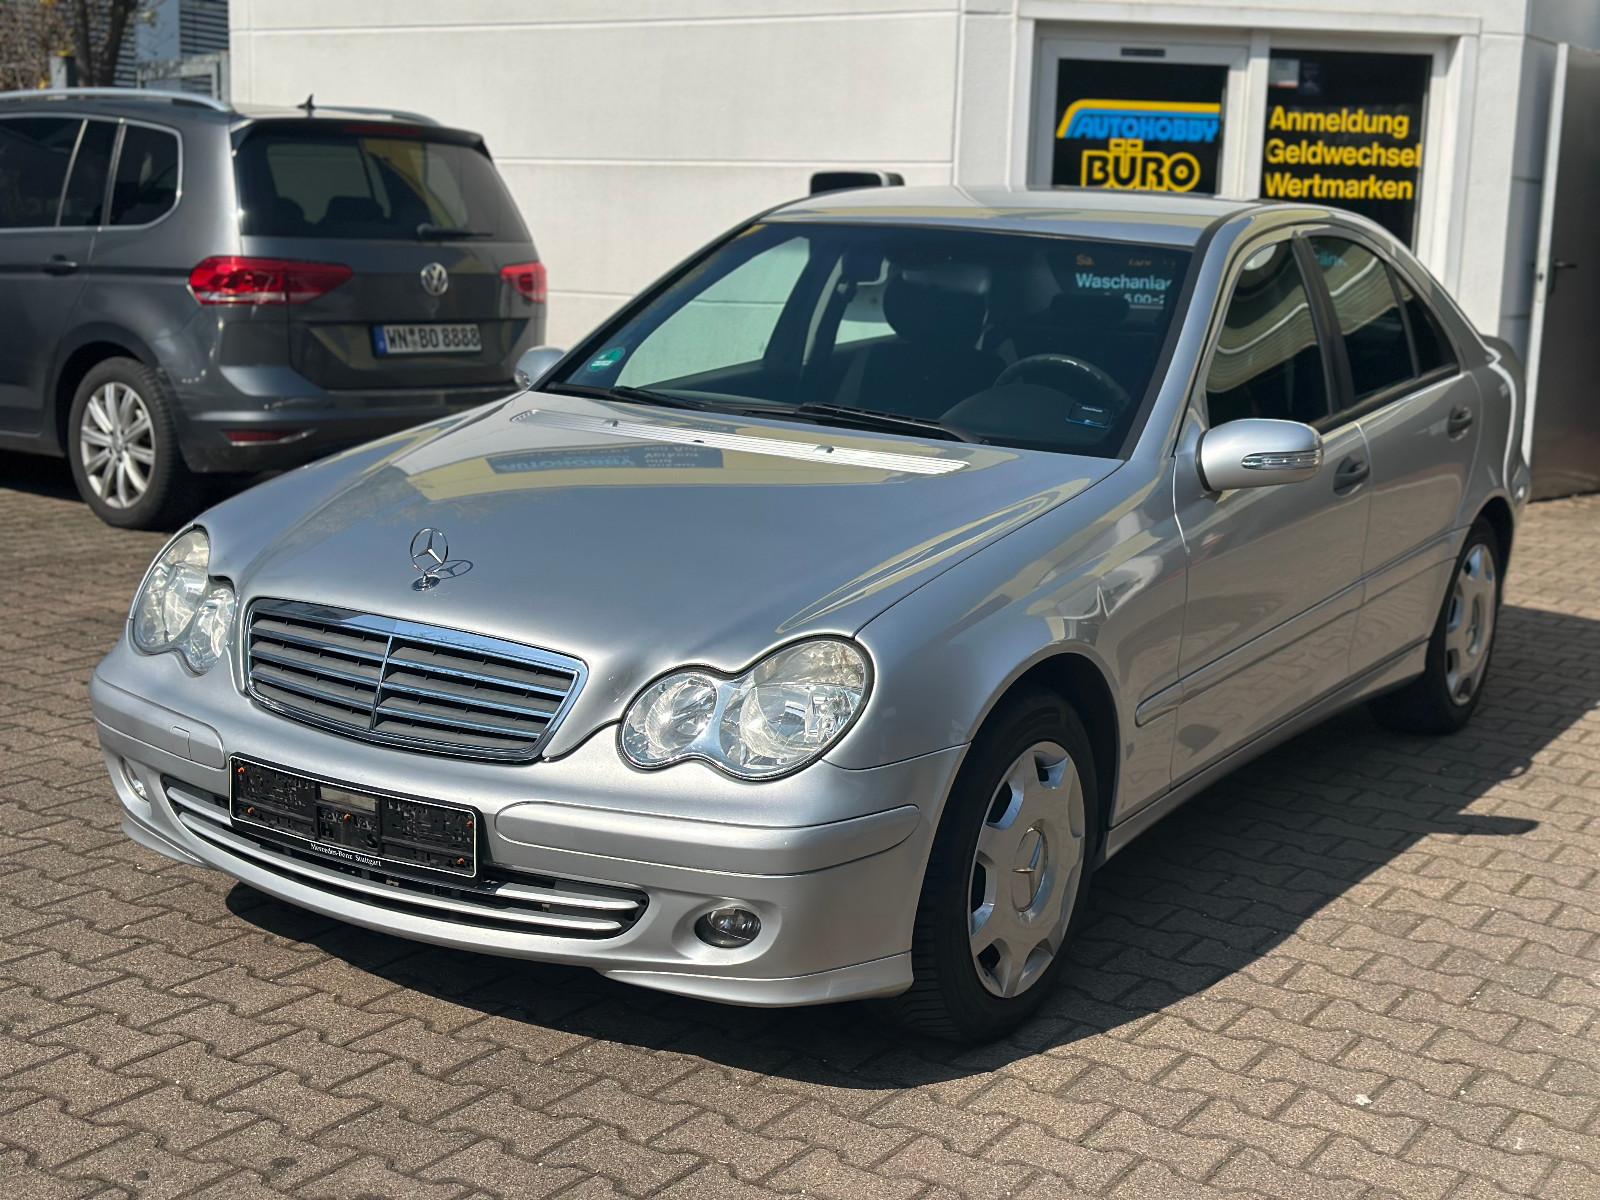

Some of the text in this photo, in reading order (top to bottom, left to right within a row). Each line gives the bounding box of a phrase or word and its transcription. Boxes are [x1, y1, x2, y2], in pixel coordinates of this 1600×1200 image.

[1073, 116, 1219, 142] AUTOHOBBY
[1270, 105, 1409, 139] Anmeldung
[1081, 138, 1200, 192] BÜRO
[1265, 138, 1422, 168] Geldwechsel
[1265, 171, 1413, 200] Wertmarken
[386, 327, 479, 349] WN BO 8888
[310, 842, 382, 867] Mercedes-Benz Stuttgart
